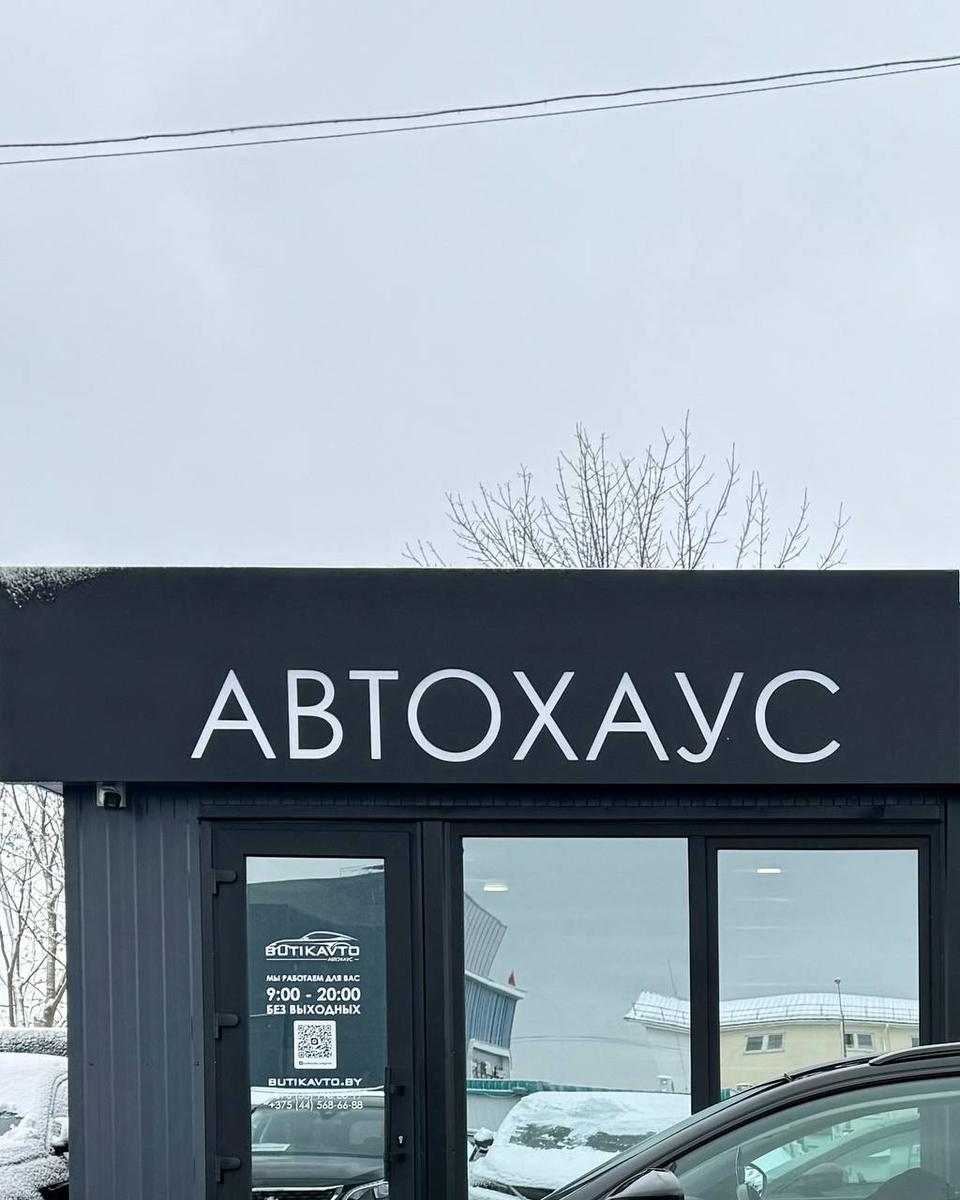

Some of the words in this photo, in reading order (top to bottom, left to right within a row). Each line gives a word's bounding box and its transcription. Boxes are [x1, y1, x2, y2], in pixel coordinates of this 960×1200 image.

[191, 668, 841, 763] АВТОХАУС
[265, 945, 360, 957] BUTIKAVTO
[325, 975, 342, 983] ДЛЯ
[266, 987, 301, 1001] 9:00
[316, 987, 361, 1001] 20:00
[266, 1004, 286, 1015] БЕЗ
[290, 1004, 361, 1016] ВЫХОДНЫХ
[268, 1078, 362, 1086] BUTIKAVTO.BY
[269, 1100, 292, 1110] +375
[295, 1099, 314, 1111] (44)
[316, 1100, 363, 1110] 568-66-88
